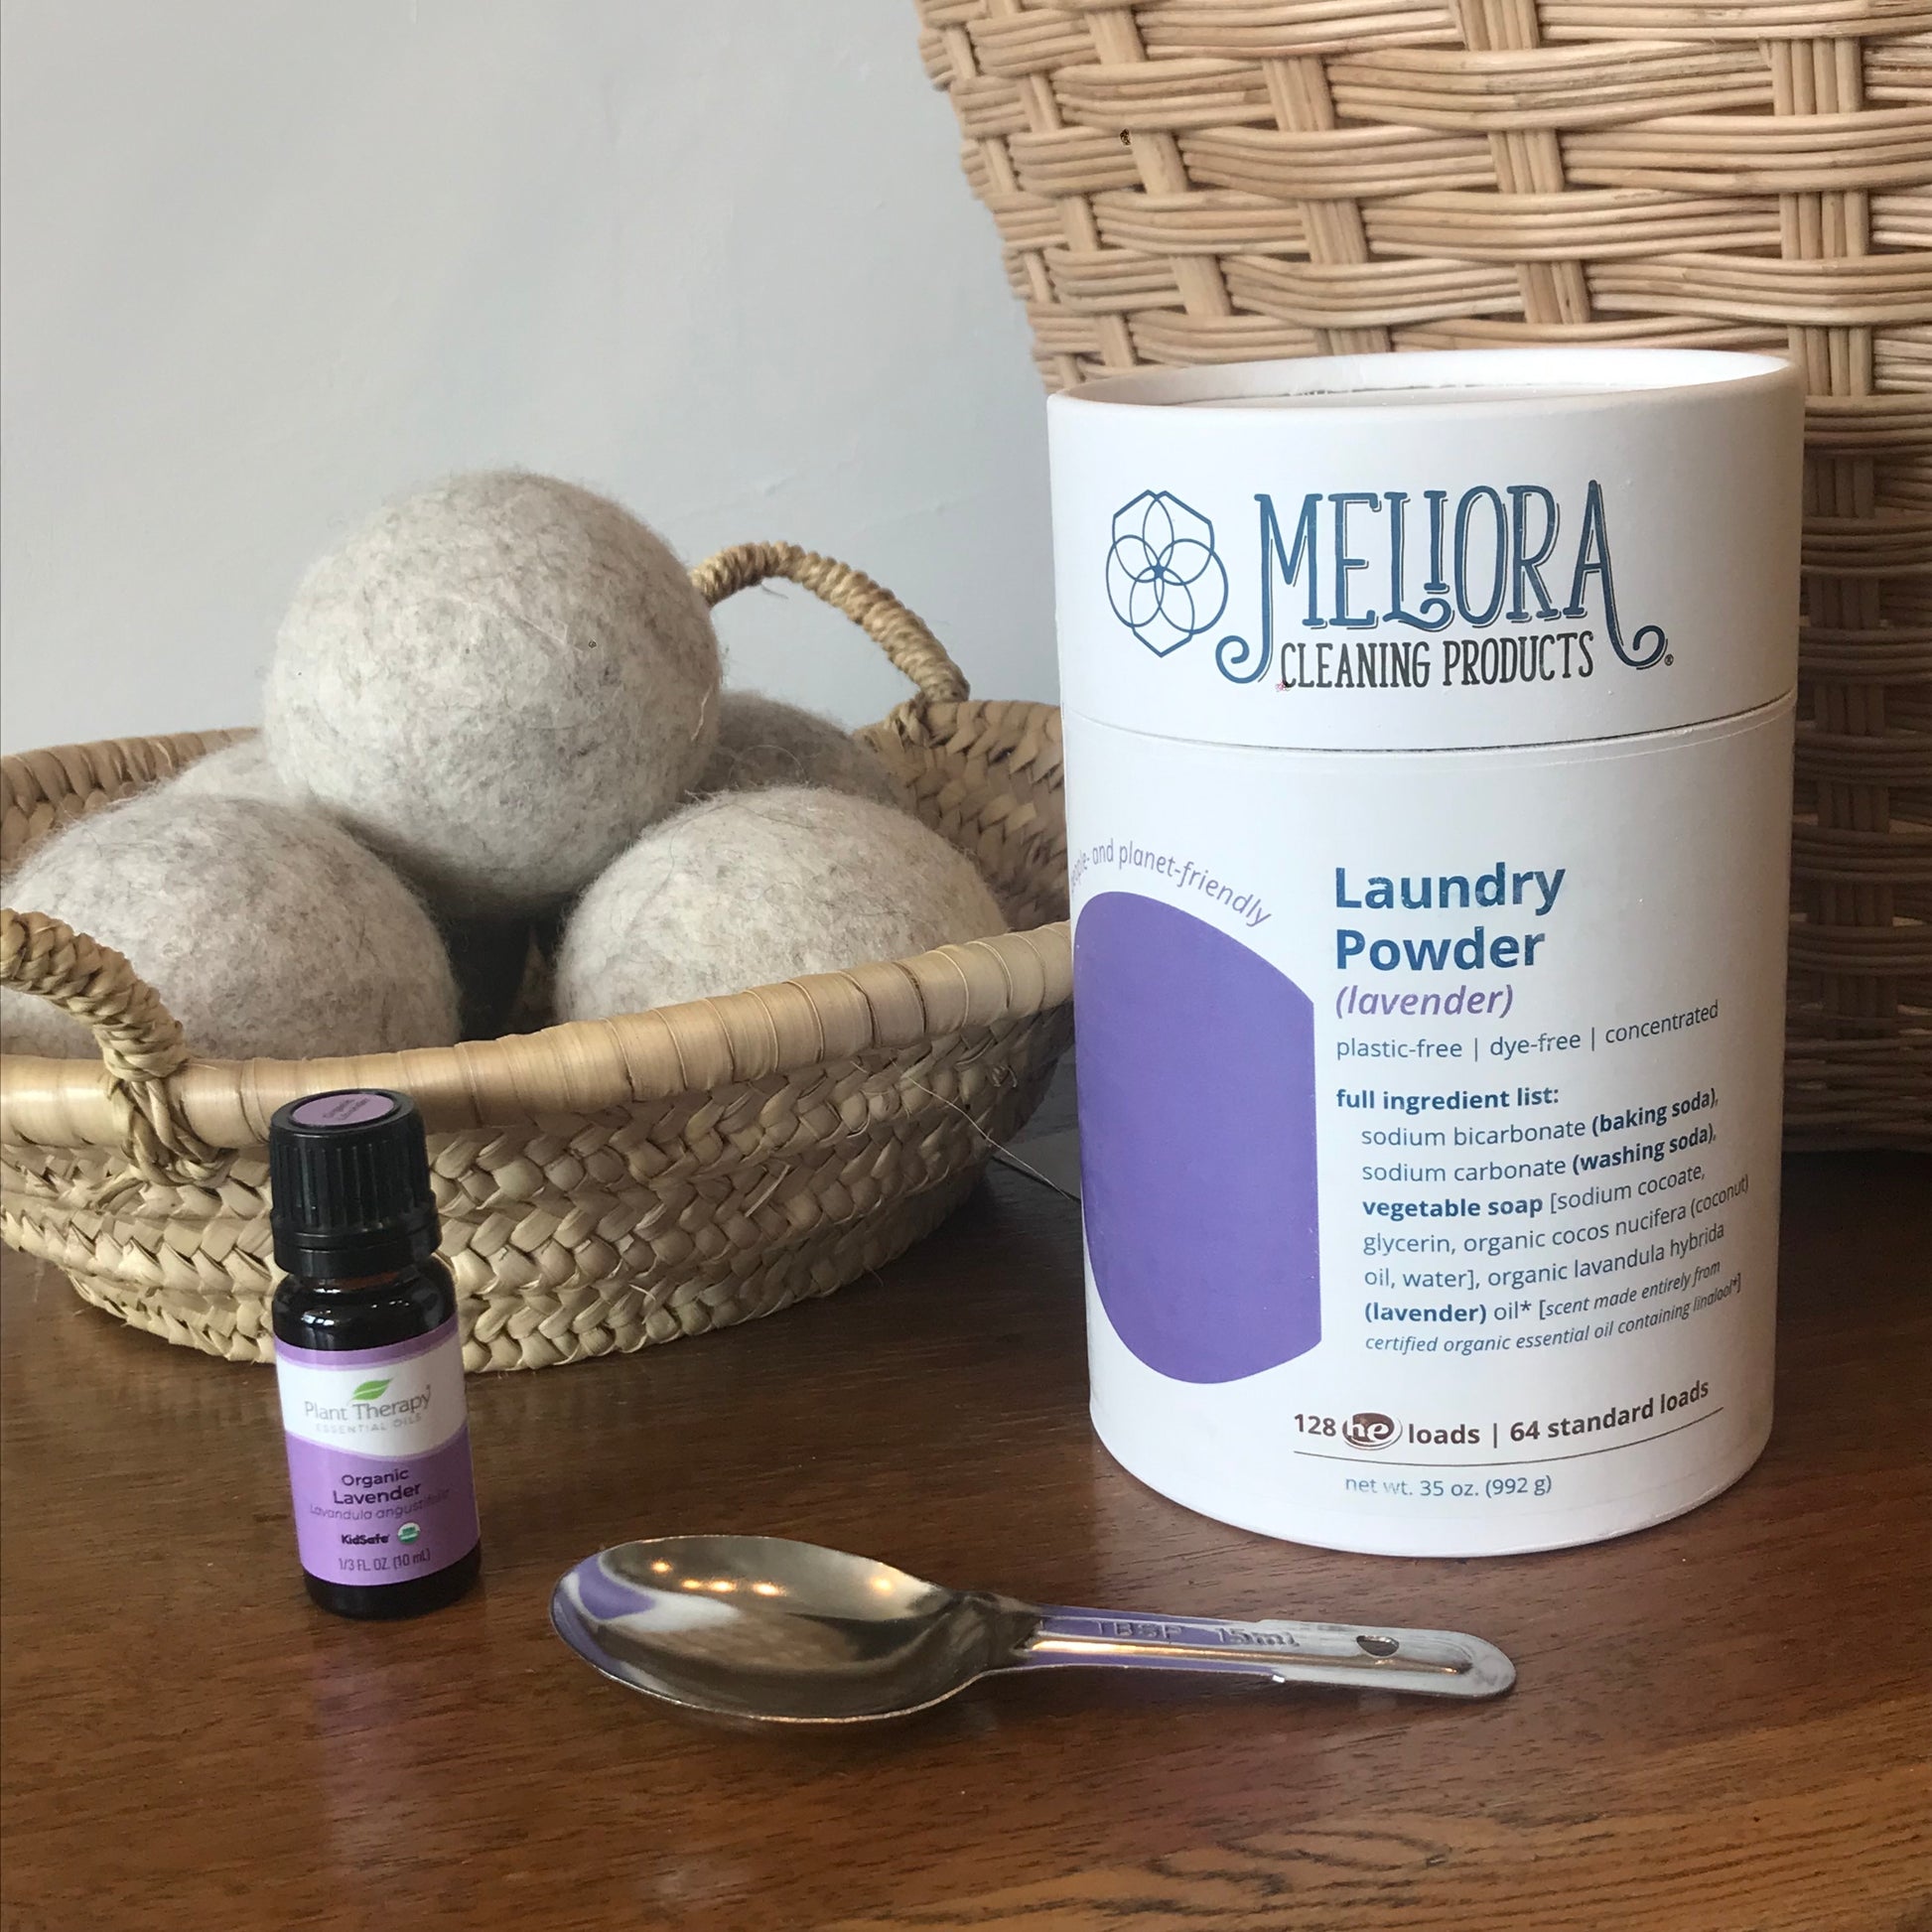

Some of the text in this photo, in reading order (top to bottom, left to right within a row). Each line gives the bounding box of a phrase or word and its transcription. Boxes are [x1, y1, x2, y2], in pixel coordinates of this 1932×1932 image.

[1215, 479, 1669, 685] MELIORA
[1281, 630, 1595, 688] CLEANING PRODUCTS
[1092, 837, 1114, 865] and
[1119, 840, 1272, 928] planet-friendly
[1335, 862, 1566, 916] Laundry
[1336, 925, 1546, 972] Powder
[1335, 984, 1514, 1019] (lavender)
[1336, 1036, 1463, 1060] plastic-free
[1489, 1032, 1582, 1060] dye-free
[1604, 1000, 1720, 1045] concentrated
[1335, 1087, 1560, 1116] full ingredient list:
[1361, 1087, 1719, 1147] sodium bicarbonate (baking soda),
[1362, 1123, 1717, 1182] sodium carbonate (washing soda),
[1362, 1164, 1706, 1222] vegetable soap [sodium cocoate,
[1363, 1173, 1749, 1257] glycerin, organic cocos nucifera (coconut)
[1364, 1222, 1725, 1291] oil, water], organic lavandula hybrida
[1364, 1303, 1488, 1324] (lavender)
[1539, 1298, 1589, 1321] [scent
[1593, 1289, 1638, 1310] made
[1641, 1272, 1692, 1301] entirely
[1692, 1260, 1721, 1289] from
[1365, 1335, 1439, 1356] certified
[1443, 1334, 1511, 1356] organic
[1515, 1324, 1590, 1349] essential
[1593, 1320, 1615, 1341] oil
[1617, 1302, 1690, 1334] containing
[304, 1390, 433, 1421] Plant Therapy
[316, 1414, 422, 1435] ESSENTIAL OILS
[1295, 1414, 1337, 1438] 128
[1345, 1411, 1391, 1445] he
[1408, 1423, 1480, 1445] loads
[1509, 1421, 1541, 1442] 64
[1547, 1397, 1655, 1439] standard
[1659, 1379, 1711, 1415] loads
[309, 1489, 450, 1520] Lavandula angust
[333, 1483, 421, 1505] Lavender
[341, 1468, 410, 1488] Organic
[1345, 1474, 1553, 1499] net wt. 35 oz. (992 g)
[339, 1558, 355, 1572] 1/3
[393, 1554, 410, 1571] (10
